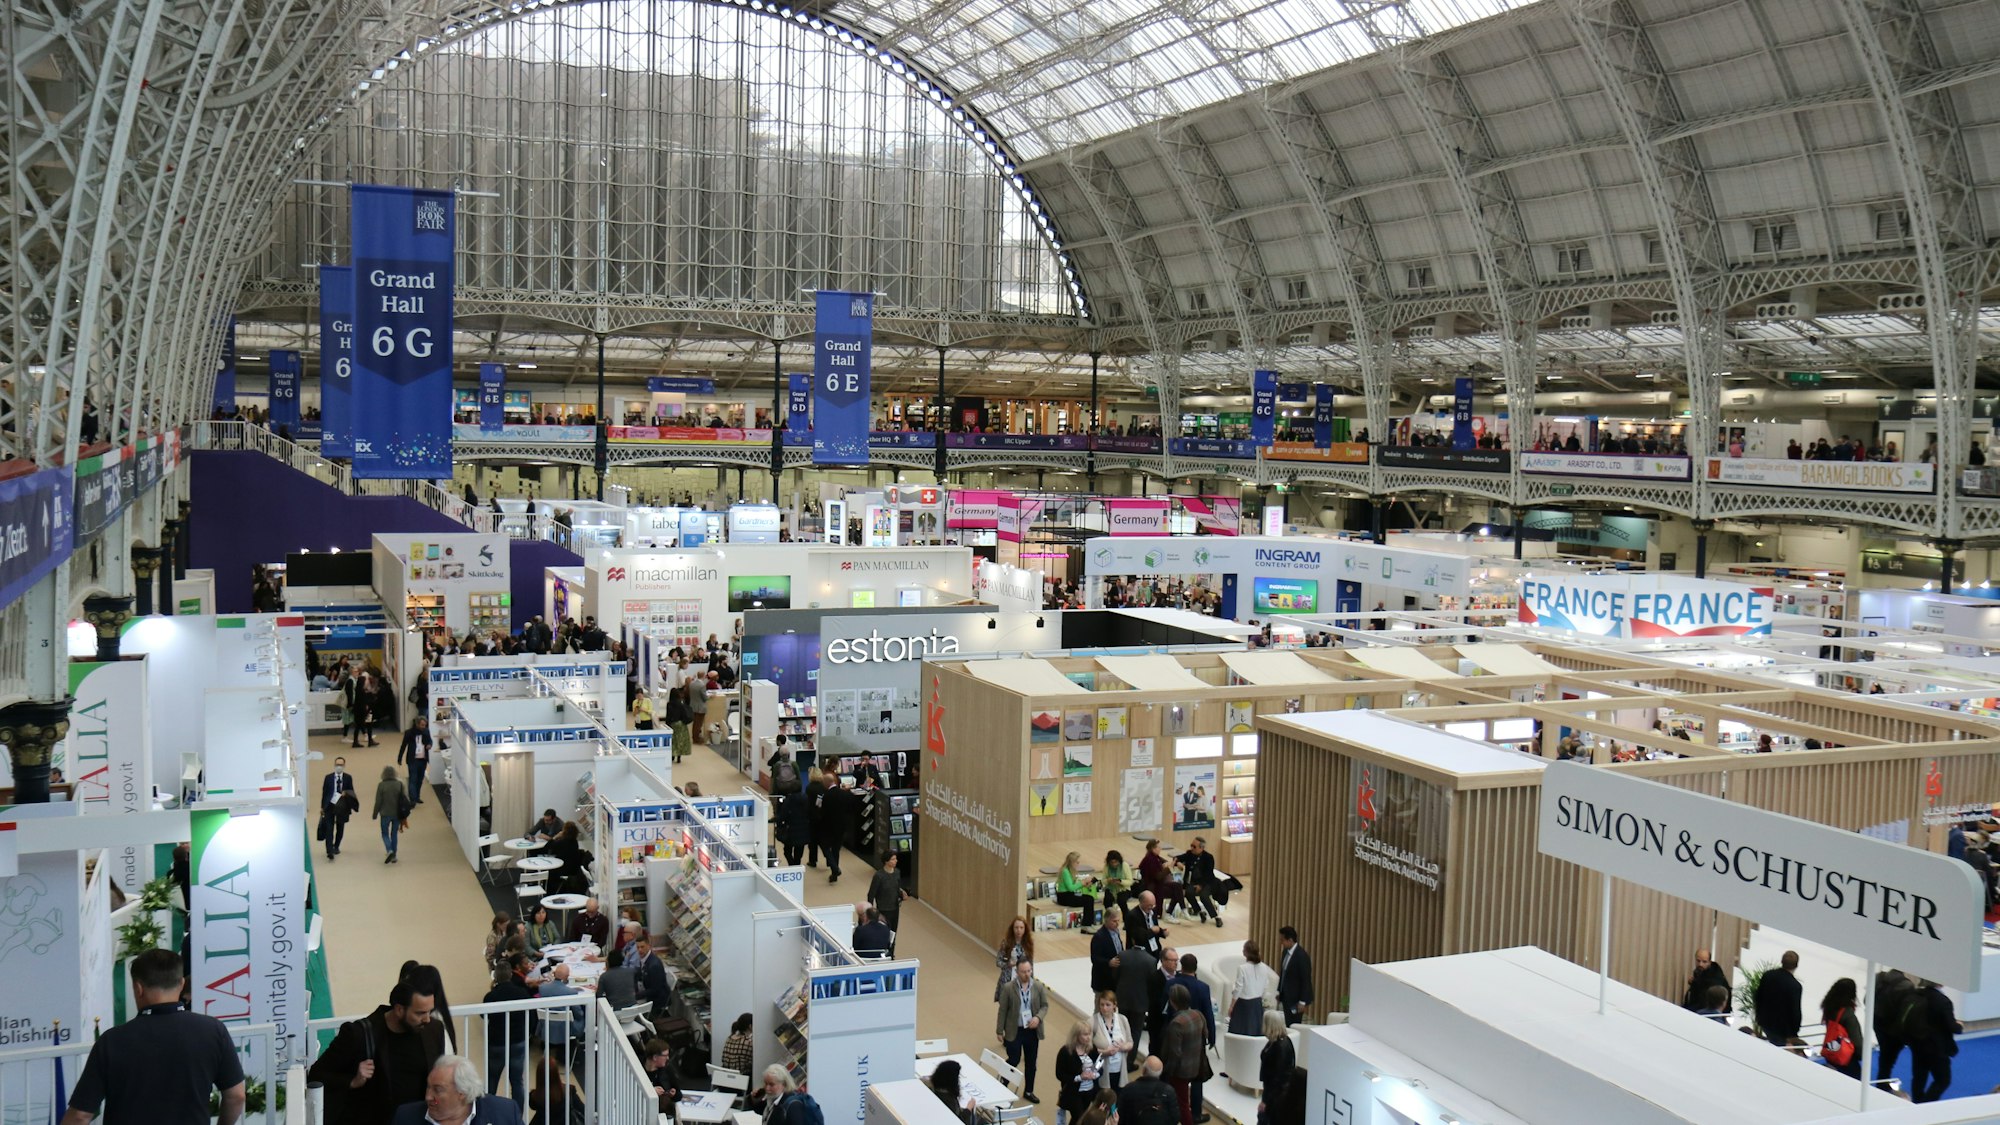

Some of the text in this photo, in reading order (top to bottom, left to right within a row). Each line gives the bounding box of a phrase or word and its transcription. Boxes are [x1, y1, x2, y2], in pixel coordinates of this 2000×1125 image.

[417, 206, 444, 214] LONDON
[423, 200, 438, 208] THE
[416, 211, 445, 221] BOOK
[416, 219, 445, 230] FAIR
[370, 270, 435, 289] Grand
[381, 295, 425, 314] Hall
[332, 321, 352, 332] Gra
[372, 326, 434, 358] 6 G
[825, 340, 862, 352] Grand
[831, 355, 855, 366] Hall
[336, 357, 351, 378] 6
[274, 372, 294, 380] Grand
[826, 373, 859, 392] 6 E
[275, 388, 294, 398] 6 G
[485, 395, 499, 404] 6 E
[792, 403, 806, 412] 6 D
[1256, 406, 1271, 416] 6 C
[1912, 406, 1927, 415] Lift
[1318, 414, 1330, 423] 6 A
[1457, 411, 1469, 421] 6 B
[1567, 460, 1595, 468] ARASOFT
[1609, 462, 1623, 470] LTD.
[1802, 463, 1903, 488] BARAMGILBOOKS
[954, 506, 997, 516] Germany
[652, 516, 677, 529] fabe
[1114, 514, 1159, 527] Germany
[1255, 548, 1320, 563] INGRAM
[853, 560, 929, 571] PAN MACMILLAN
[1255, 561, 1291, 569] CONTENT
[1888, 560, 1903, 570] Lift
[635, 566, 718, 581] macmillan
[987, 579, 1035, 602] PAN MACMILLAN
[1523, 581, 1625, 623] FRANCE
[1634, 592, 1763, 625] FRANCE
[41, 639, 48, 647] 3
[827, 628, 960, 664] estonia
[77, 697, 110, 806] TALIA
[624, 828, 666, 842] PGUK
[925, 799, 1011, 867] Sharjah Book Authority
[1355, 846, 1438, 892] Sharjah Book Authority
[1556, 795, 1941, 940] SIMON & SCHUSTER
[775, 873, 803, 884] 6E30
[205, 861, 251, 1060] TALIA
[857, 1054, 869, 1121] Group UK
